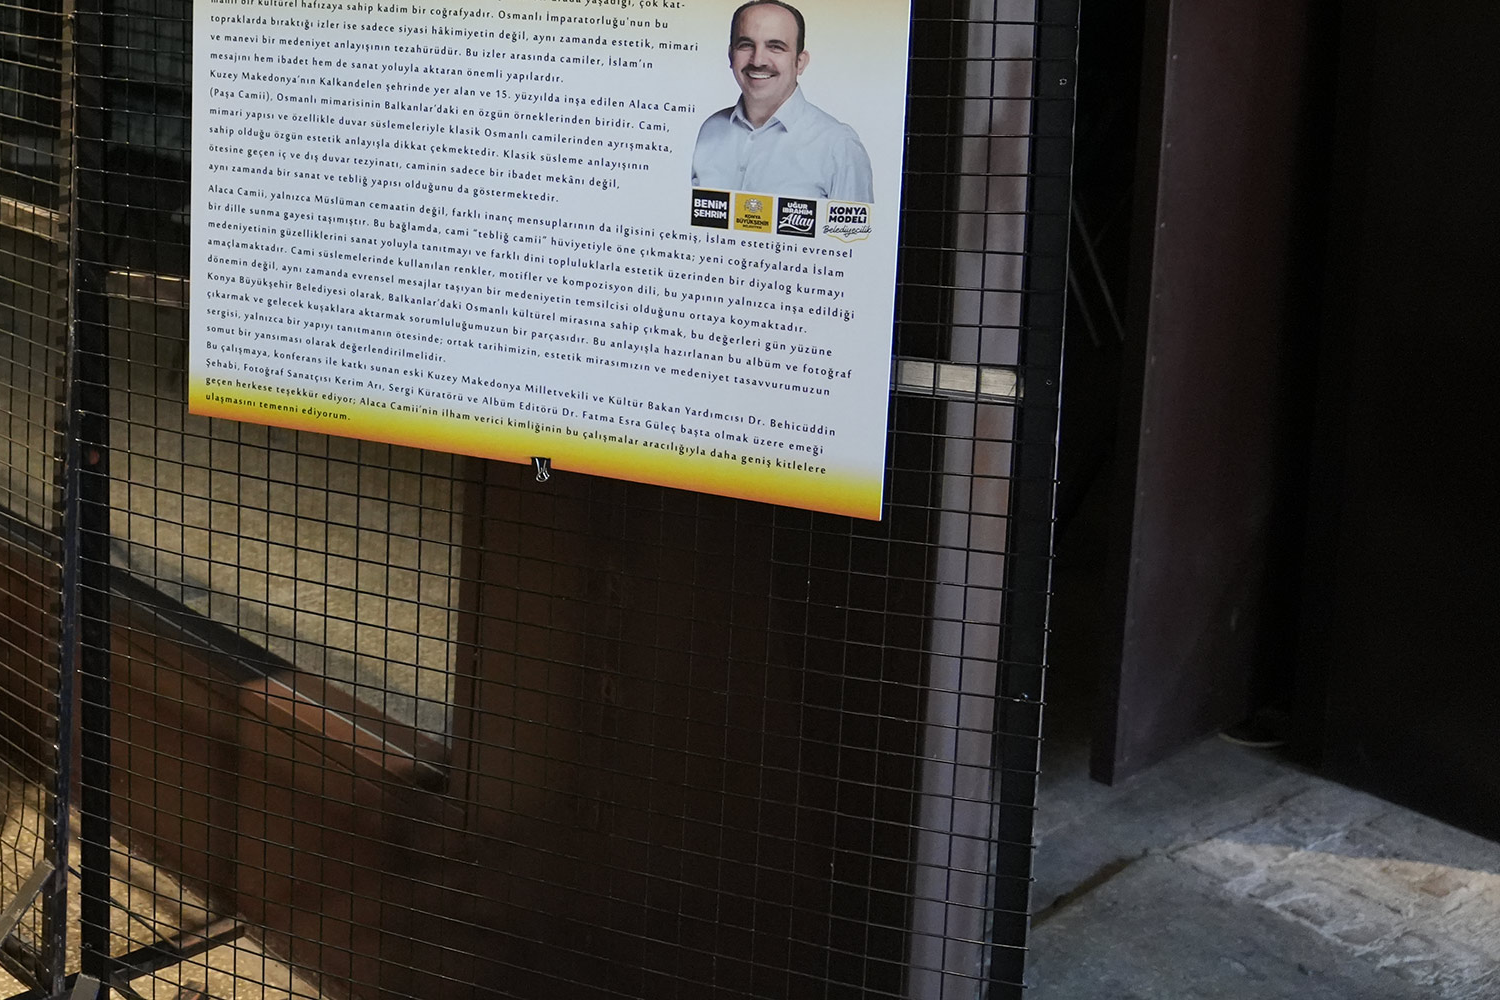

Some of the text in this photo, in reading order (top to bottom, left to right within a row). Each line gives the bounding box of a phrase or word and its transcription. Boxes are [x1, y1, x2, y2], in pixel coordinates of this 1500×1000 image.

[210, 14, 698, 51] topraklarda bıraktığı izler ise sadece siyasi hâkimiyetin değil, aynı zamanda estetik, mimari
[209, 69, 239, 82] Kuzey
[319, 76, 382, 89] Kalkandelen
[385, 81, 431, 93] şehrinde
[432, 87, 451, 96] yer
[453, 86, 476, 96] alan
[495, 89, 511, 99] 15.
[513, 91, 561, 104] yüzyılda
[564, 94, 587, 106] inşa
[590, 96, 625, 107] edilen
[628, 99, 660, 110] Alaca
[663, 102, 696, 112] Camii
[209, 106, 243, 116] mimari
[244, 111, 275, 121] yapısı
[291, 113, 336, 124] özellikle
[338, 116, 367, 126] duvar
[370, 119, 445, 135] süslemeleriyle
[449, 124, 481, 136] klasik
[484, 127, 528, 140] Osmanlı
[531, 133, 604, 146] camilerinden
[607, 140, 673, 153] ayrışmakta,
[208, 143, 244, 154] ötesine
[247, 148, 275, 158] geçen
[278, 149, 287, 160] iç
[304, 151, 319, 163] dış
[321, 152, 351, 163] duvar
[353, 157, 402, 169] tezyinatı,
[405, 162, 447, 172] caminin
[450, 164, 486, 175] sadece
[489, 167, 505, 177] bir
[507, 169, 542, 181] ibadet
[545, 173, 585, 185] mekânı
[588, 176, 620, 190] değil,
[207, 184, 853, 258] Alaca Camii, yalnızca Müslüman cemaatin değil, farklı inanç mensuplarının da ilgisini çekmiş, İslam estetiğini evrensel
[778, 213, 814, 231] Altay
[822, 224, 872, 238] Belediyecilik
[829, 206, 867, 215] KONYA
[207, 238, 855, 322] amaçlamaktadır. Cami süslemelerinde kullanılan renkler, motifler ve kompozisyon dili, bu yapının yalnızca inşa edildiği
[207, 254, 807, 333] dönemin değil, aynı zamanda evrensel mesajlar taşıyan bir medeniyetin temsilcisi olduğunu ortaya koymaktadır.
[205, 392, 351, 420] ulaşmasını temenni ediyorum.
[206, 340, 218, 349] Bu
[220, 343, 271, 358] çalışmaya,
[273, 349, 322, 364] konferans
[325, 356, 338, 366] ile
[341, 358, 367, 370] katkı
[370, 364, 400, 374] sunan
[403, 367, 424, 378] eski
[427, 370, 458, 385] Kuzey
[461, 375, 521, 392] Makedonya
[524, 384, 589, 400] Milletvekili
[608, 395, 644, 408] Kültür
[647, 400, 681, 413] Bakan
[684, 406, 744, 423] Yardımcısı
[748, 415, 765, 426] Dr.
[770, 418, 836, 436] Behicüddin
